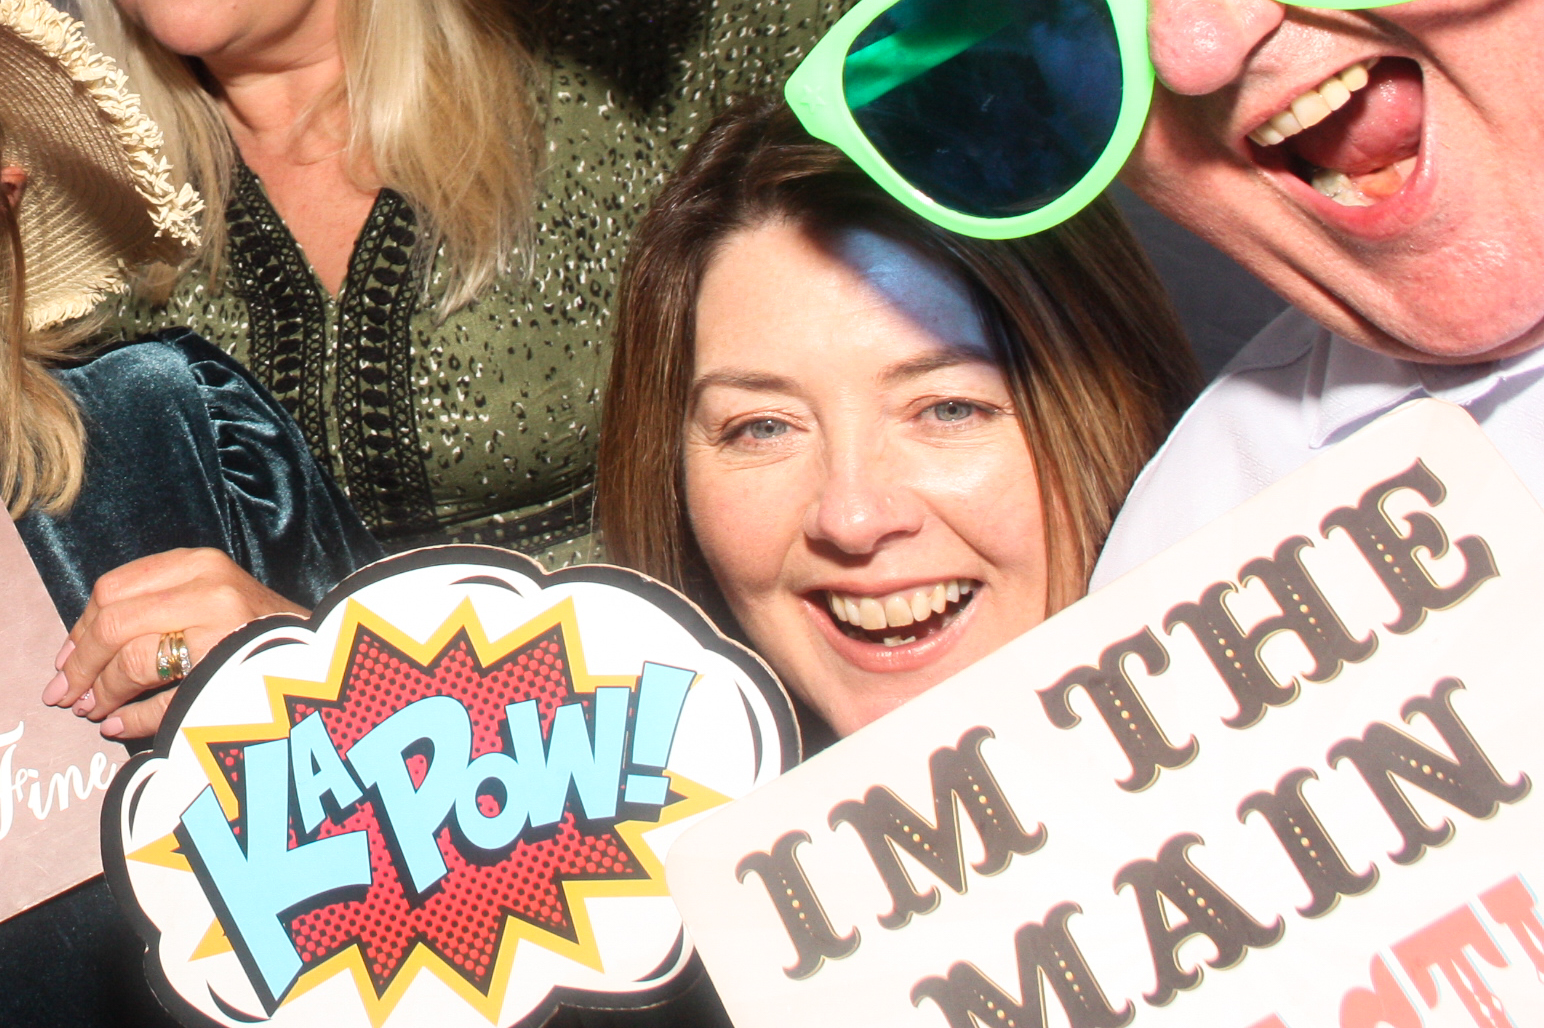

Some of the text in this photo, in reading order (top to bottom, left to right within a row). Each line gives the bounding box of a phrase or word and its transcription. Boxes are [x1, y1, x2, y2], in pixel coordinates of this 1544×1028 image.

[176, 660, 697, 1010] KAPOW!
[735, 725, 1048, 981] IM
[1036, 457, 1501, 792] THE
[910, 675, 1532, 1028] MAIN
